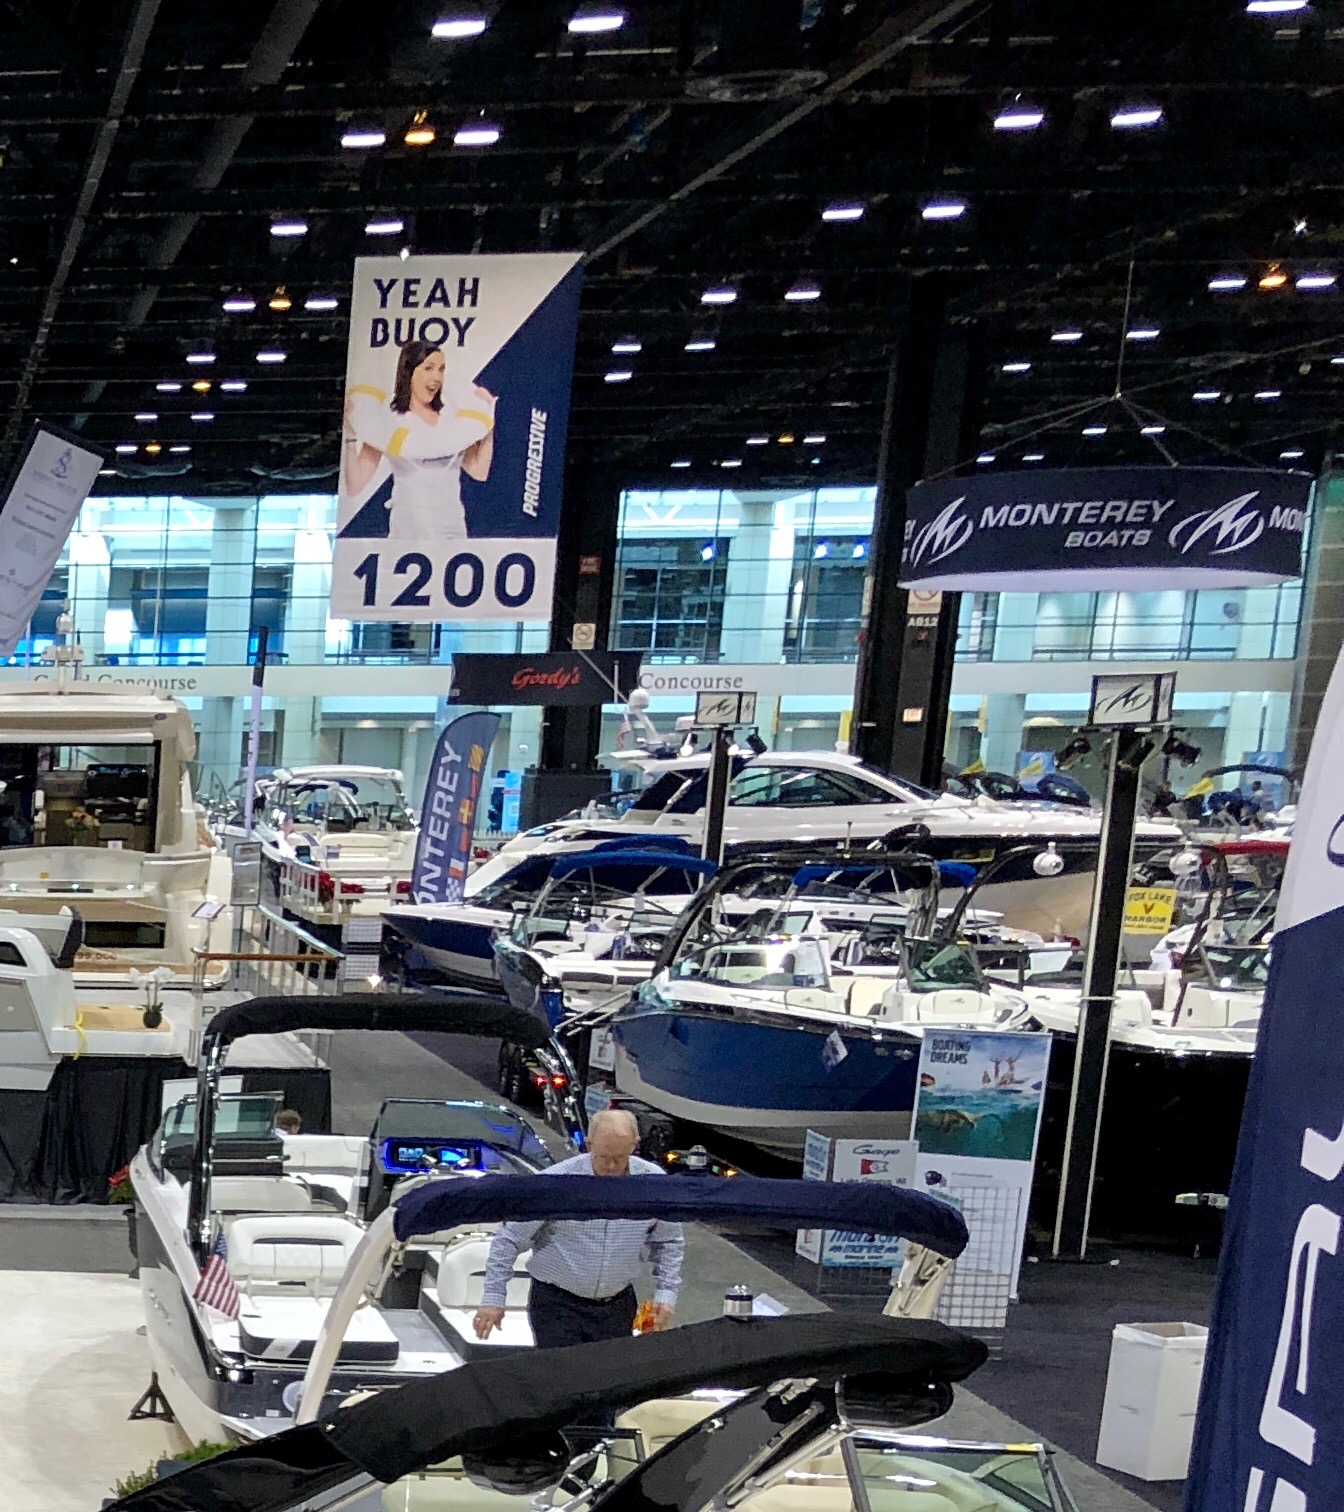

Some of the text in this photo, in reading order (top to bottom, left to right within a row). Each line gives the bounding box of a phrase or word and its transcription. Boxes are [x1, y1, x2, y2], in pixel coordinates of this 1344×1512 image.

[373, 277, 480, 308] YEAH
[370, 316, 476, 348] BUOY
[521, 407, 548, 518] PROGRESSIVE
[979, 498, 1175, 530] MONTEREY
[1064, 529, 1154, 549] BOATS
[352, 551, 536, 608] 1200
[511, 666, 582, 690] Gordy's
[637, 672, 743, 690] Concourse
[929, 1051, 969, 1065] DREAMS
[931, 1038, 971, 1052] BOATING
